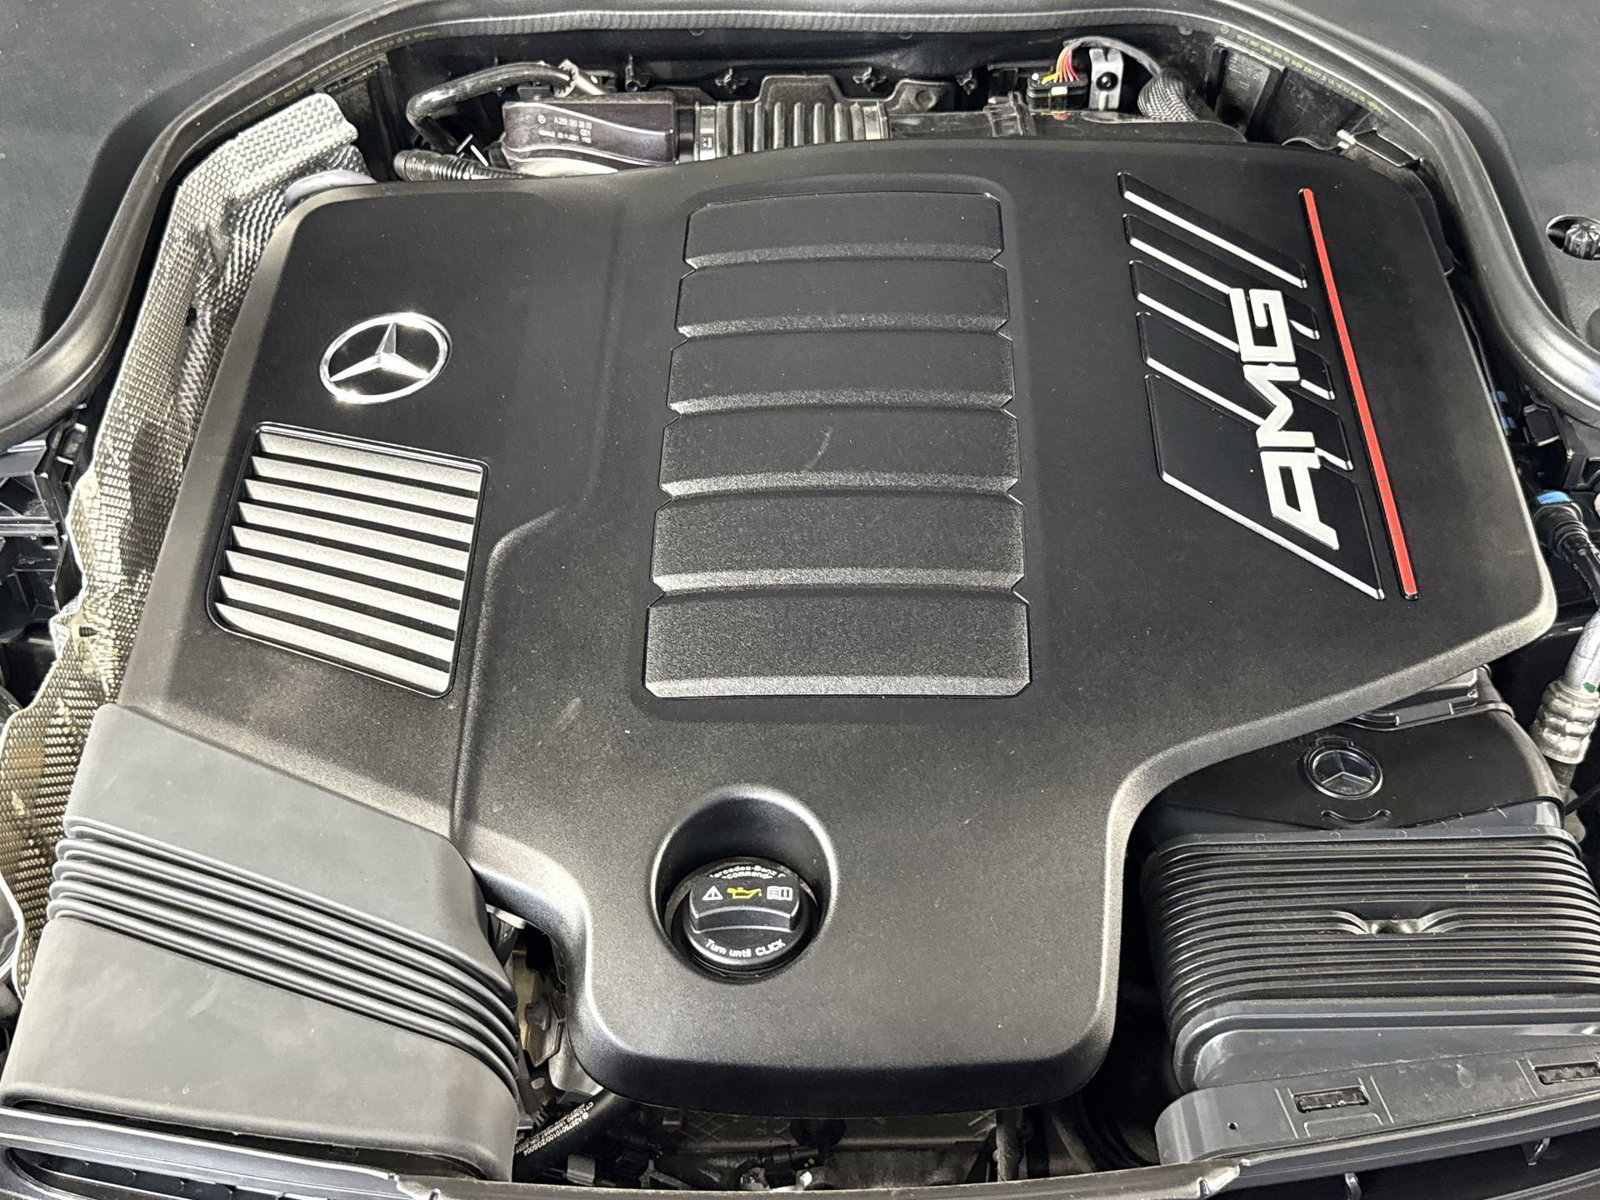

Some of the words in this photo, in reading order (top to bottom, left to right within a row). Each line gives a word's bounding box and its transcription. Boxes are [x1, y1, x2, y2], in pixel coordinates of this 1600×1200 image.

[1229, 288, 1340, 551] AMG
[705, 938, 726, 954] Turn
[729, 948, 752, 958] until
[755, 938, 787, 956] CLICK
